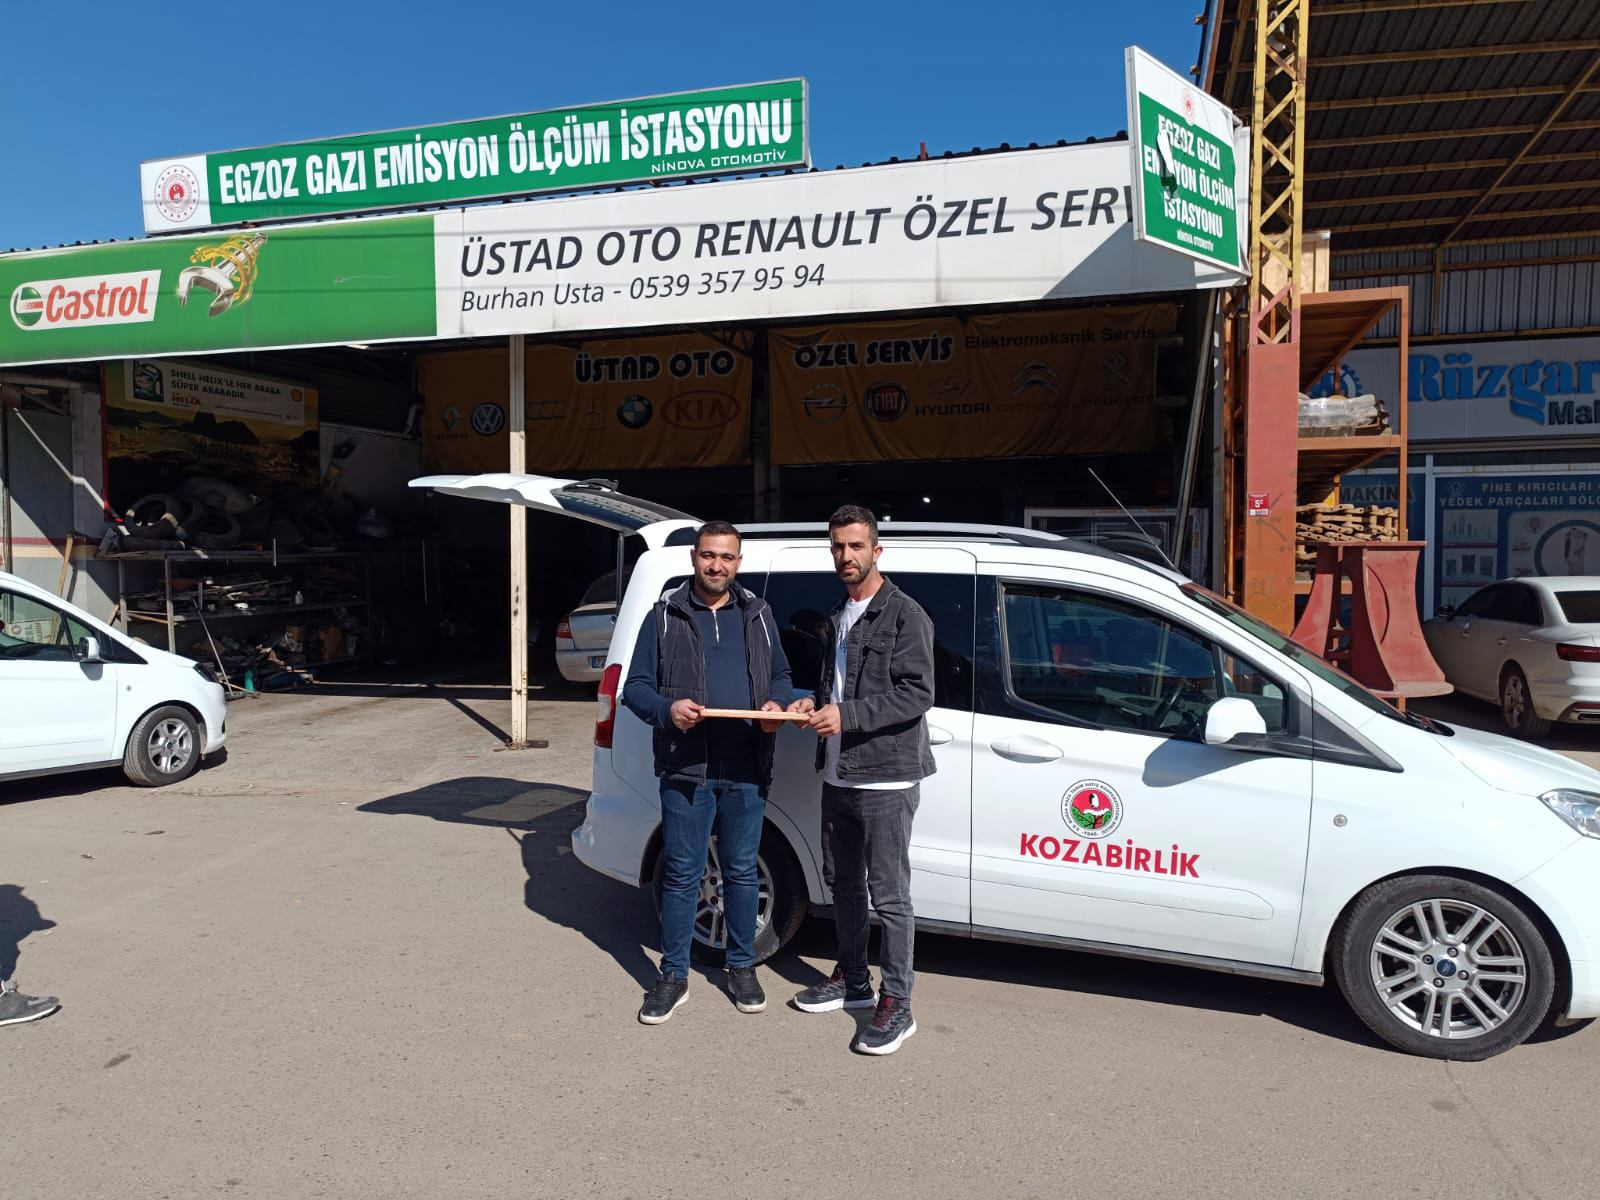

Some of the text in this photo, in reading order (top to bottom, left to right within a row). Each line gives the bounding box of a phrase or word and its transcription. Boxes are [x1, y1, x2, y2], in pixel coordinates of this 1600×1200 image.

[218, 156, 299, 205] EGZOZ
[306, 150, 366, 196] GAZI
[375, 133, 500, 189] EMİSYON
[509, 116, 611, 176] ÖLÇÜM
[619, 97, 793, 161] İSTASYONU
[1158, 114, 1220, 171] EGZOZ GAZI
[651, 149, 787, 173] NİNOVA OTOMOTİV
[1144, 144, 1234, 211] EMYON ÖLÇÜM
[1163, 192, 1223, 239] İSTASYONU
[461, 235, 583, 277] ÜSTAD
[599, 226, 681, 265] OTO
[694, 206, 891, 259] RENAULT
[903, 195, 1017, 240] ÖZEL
[46, 278, 149, 323] Castrol
[461, 288, 545, 312] Burhan
[553, 281, 605, 306] Usta
[629, 275, 690, 300] 0539
[697, 270, 744, 295] 357
[753, 266, 784, 291] 95
[793, 263, 826, 288] 94
[795, 332, 954, 369] ÖZEL SERVİS
[965, 328, 1157, 350] Elektromekanik Servis
[171, 368, 196, 381] SHELL
[236, 380, 252, 391] HER
[254, 383, 281, 396] ARABA
[575, 350, 736, 382] ÜSTAD OTO
[171, 379, 199, 393] SÜPER
[874, 391, 901, 411] FIAT
[1408, 353, 1600, 425] Rüzgar
[675, 398, 728, 422] KIA
[915, 402, 991, 417] HYUNDAI
[1440, 497, 1483, 508] YEDEK
[1488, 495, 1564, 509] PARÇALARI
[1482, 481, 1512, 493] FİNE
[1517, 481, 1592, 493] KIRICILARI
[1020, 833, 1200, 878] KOZABİRLİK
